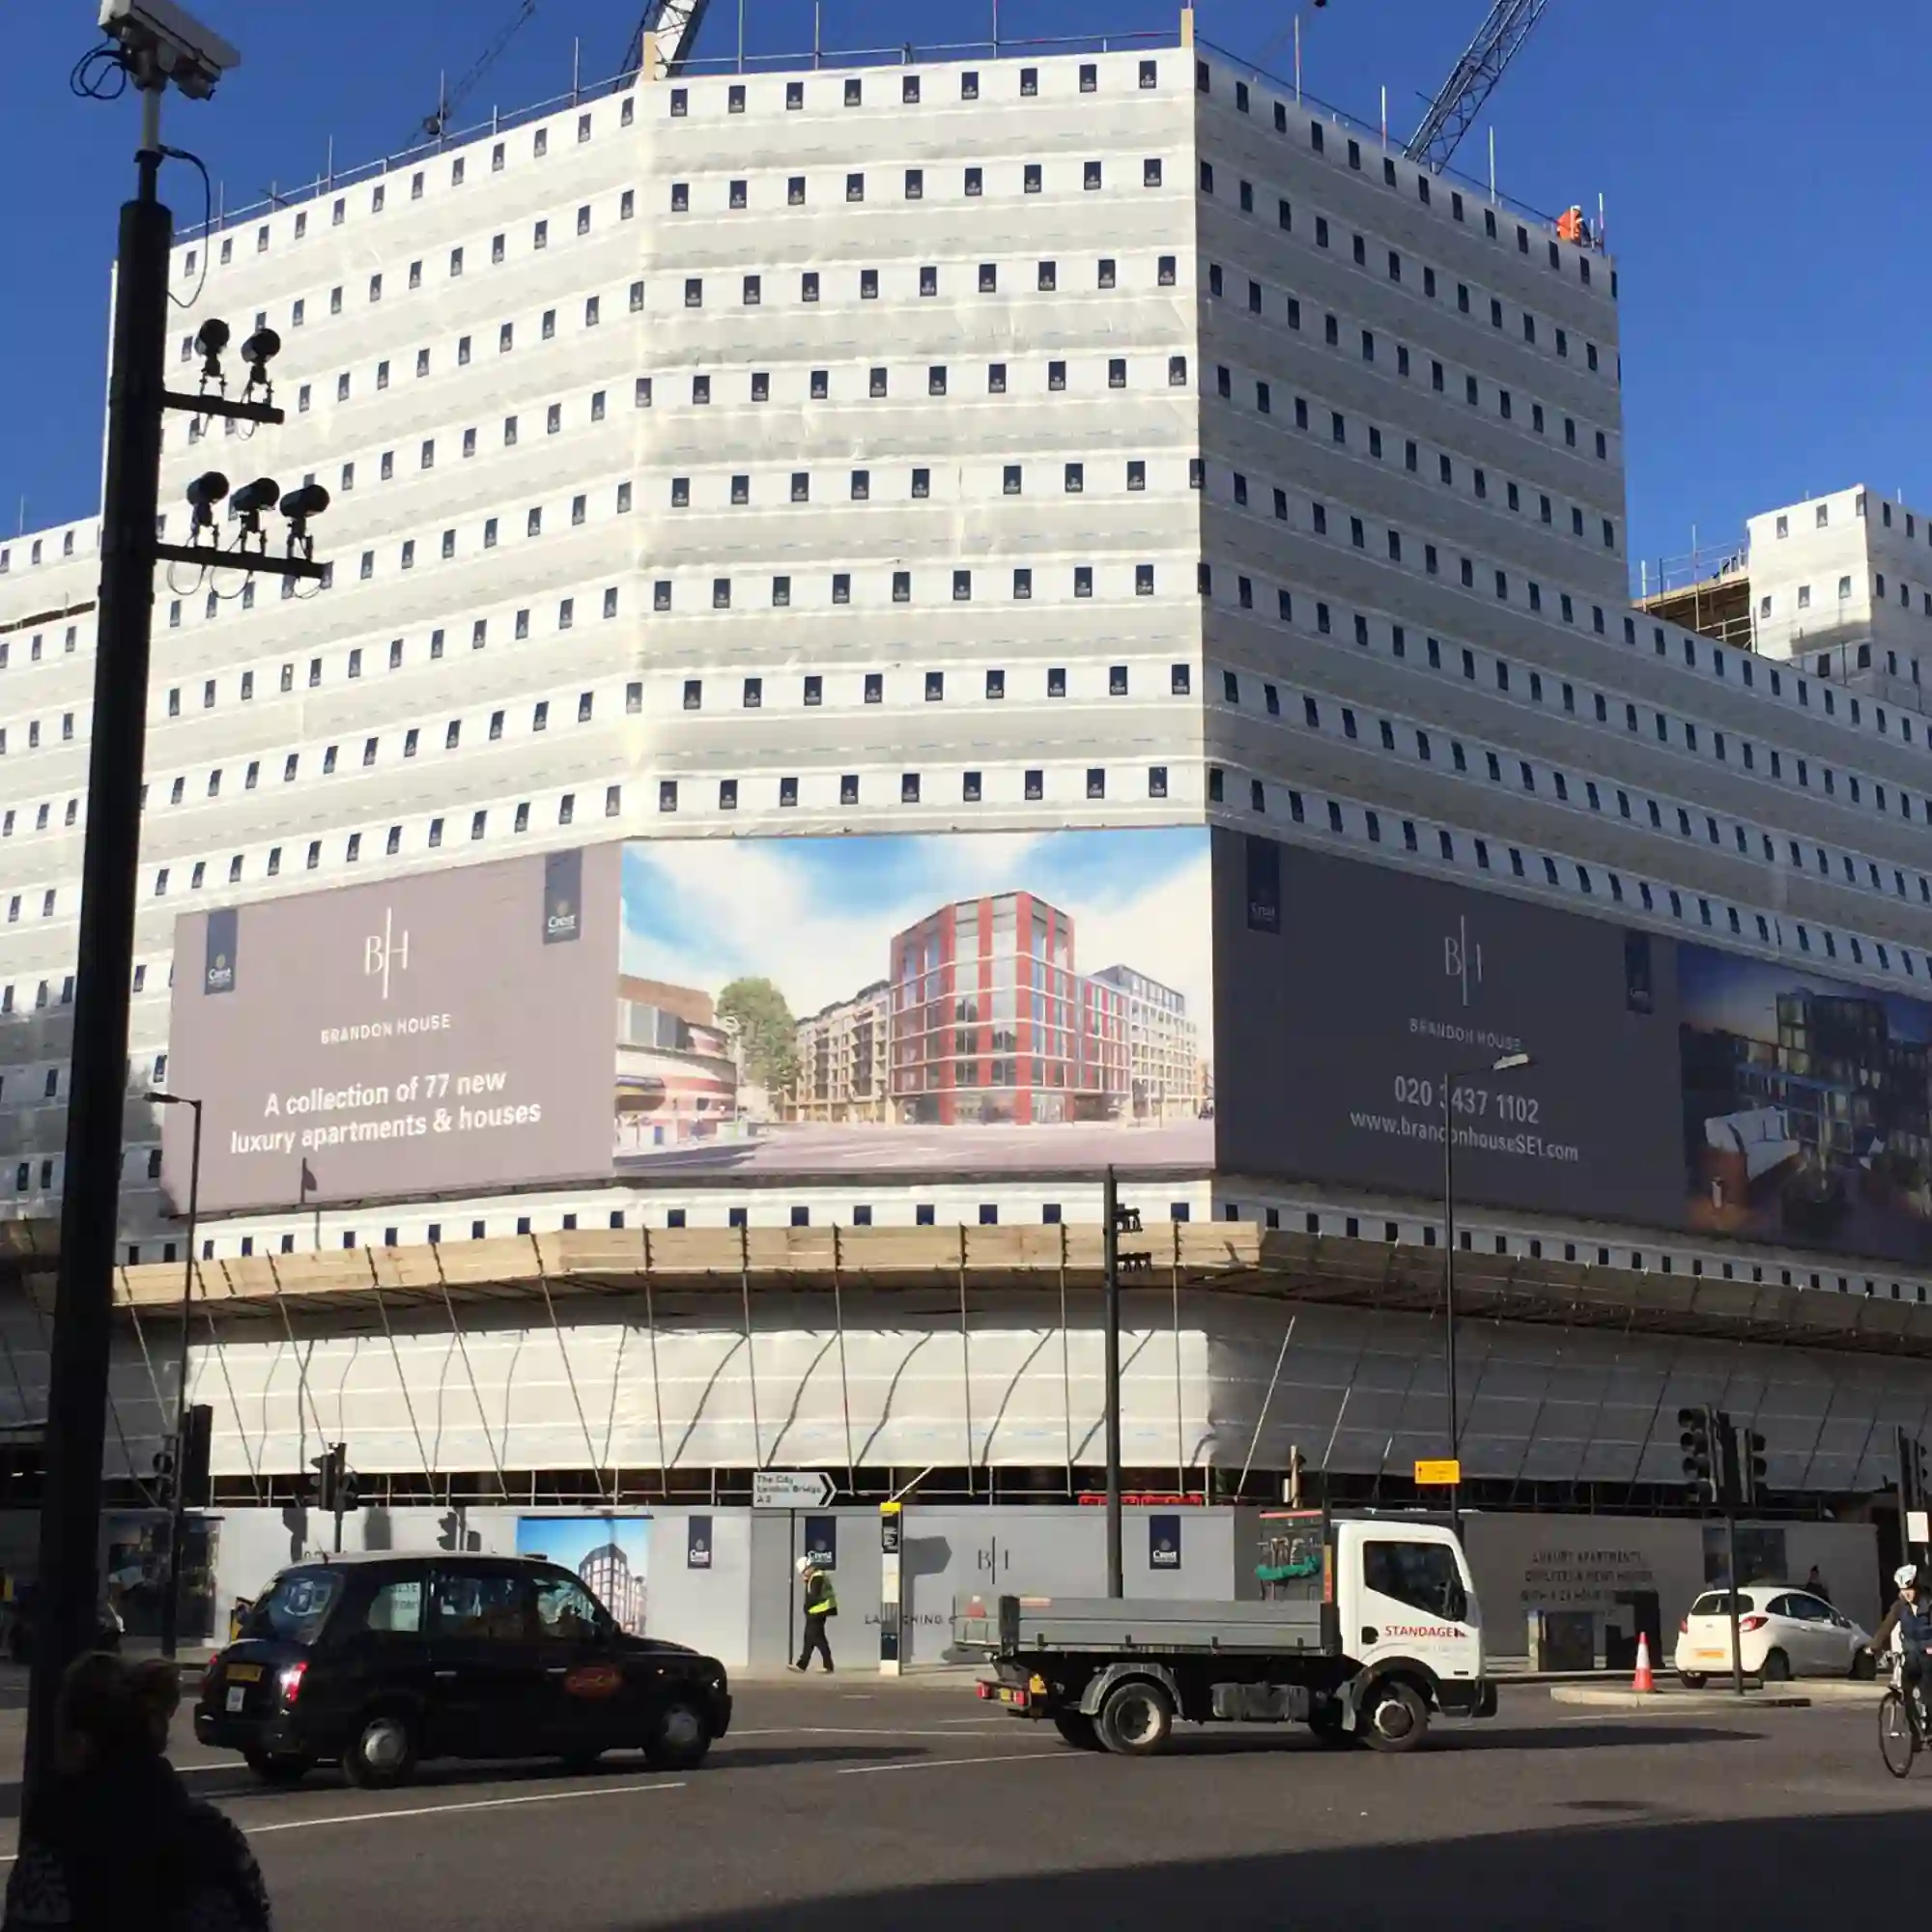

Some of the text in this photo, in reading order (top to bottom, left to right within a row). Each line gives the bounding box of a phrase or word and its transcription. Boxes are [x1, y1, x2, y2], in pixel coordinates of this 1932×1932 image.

[321, 1013, 451, 1044] BRANDON HOUSE
[1408, 1017, 1521, 1053] BRANDON HOUSE
[264, 1071, 507, 1117] A collection of 77 new
[1394, 1075, 1433, 1107] 020
[1495, 1093, 1540, 1123] 1102
[231, 1102, 542, 1154] luxury apartments & houses
[756, 1474, 793, 1485] The City
[792, 1485, 822, 1494] Bridge
[1385, 1625, 1453, 1638] STANDAGE
